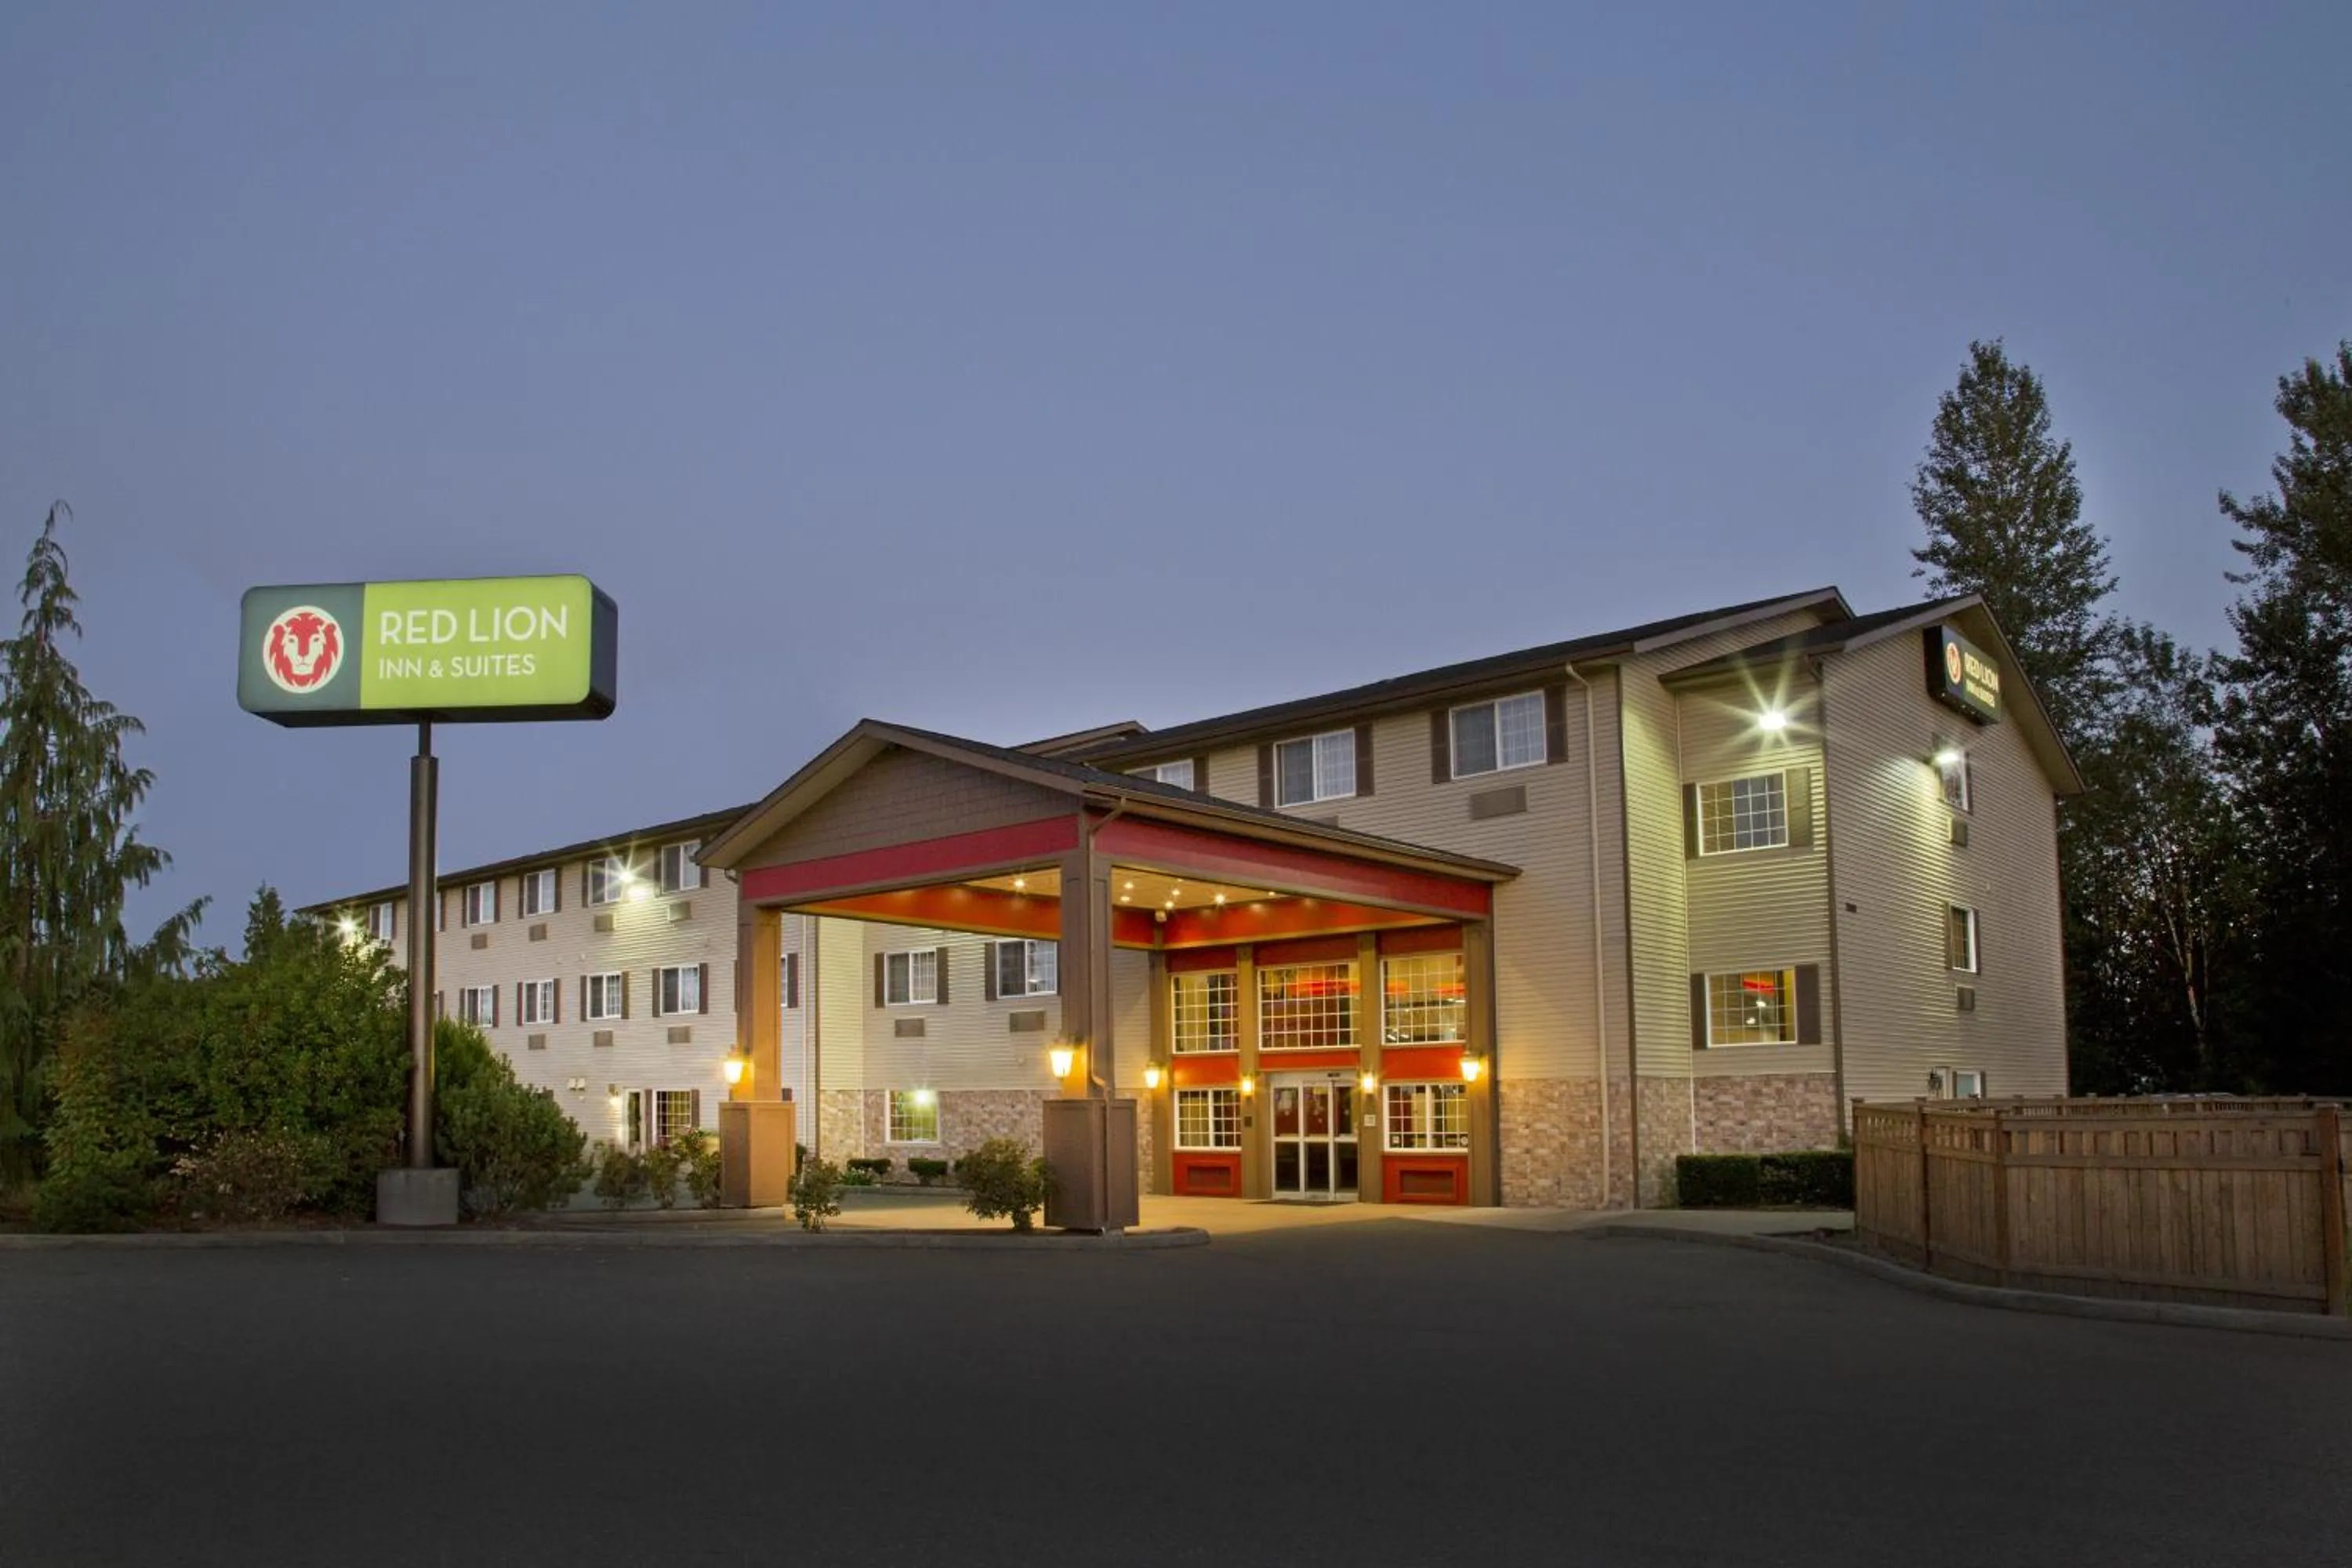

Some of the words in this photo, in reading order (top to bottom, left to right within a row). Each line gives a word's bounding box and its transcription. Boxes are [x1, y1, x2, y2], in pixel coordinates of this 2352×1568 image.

[379, 609, 458, 644] RED
[469, 604, 568, 642] LION
[379, 658, 423, 679] INN
[429, 659, 444, 679] &
[451, 654, 535, 678] SUITES
